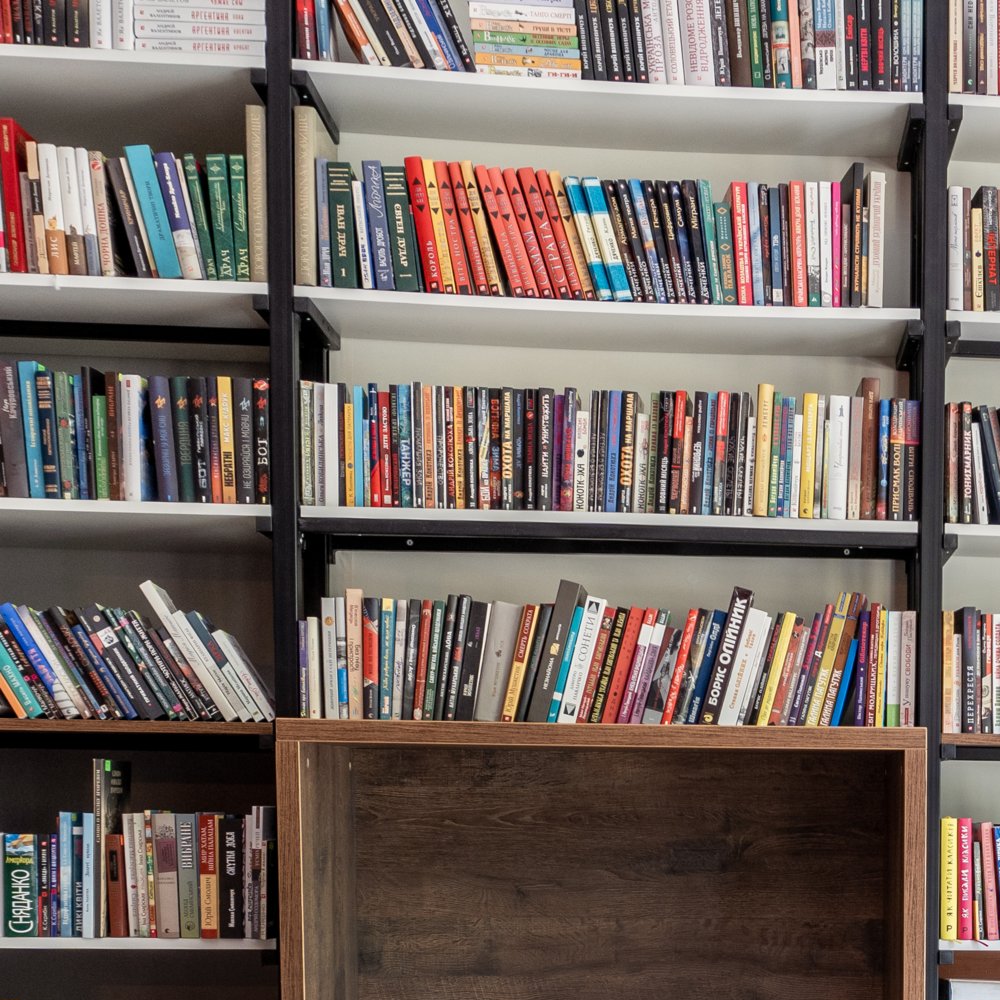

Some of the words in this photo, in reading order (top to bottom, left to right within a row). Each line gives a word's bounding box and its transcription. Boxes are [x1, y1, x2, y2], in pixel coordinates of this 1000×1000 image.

[96, 203, 108, 235] ДОШКА
[45, 237, 59, 258] ЛИС
[101, 237, 110, 266] ЧОРНА
[426, 241, 437, 278] КОРОЛЬ
[539, 221, 566, 284] СТРАТА
[502, 441, 513, 479] ОХОТА
[620, 446, 633, 487] ОХОТА
[577, 616, 597, 662] СОНЕТИ
[708, 667, 724, 706] БОРИС
[719, 597, 748, 665] ОЛІЙНИК
